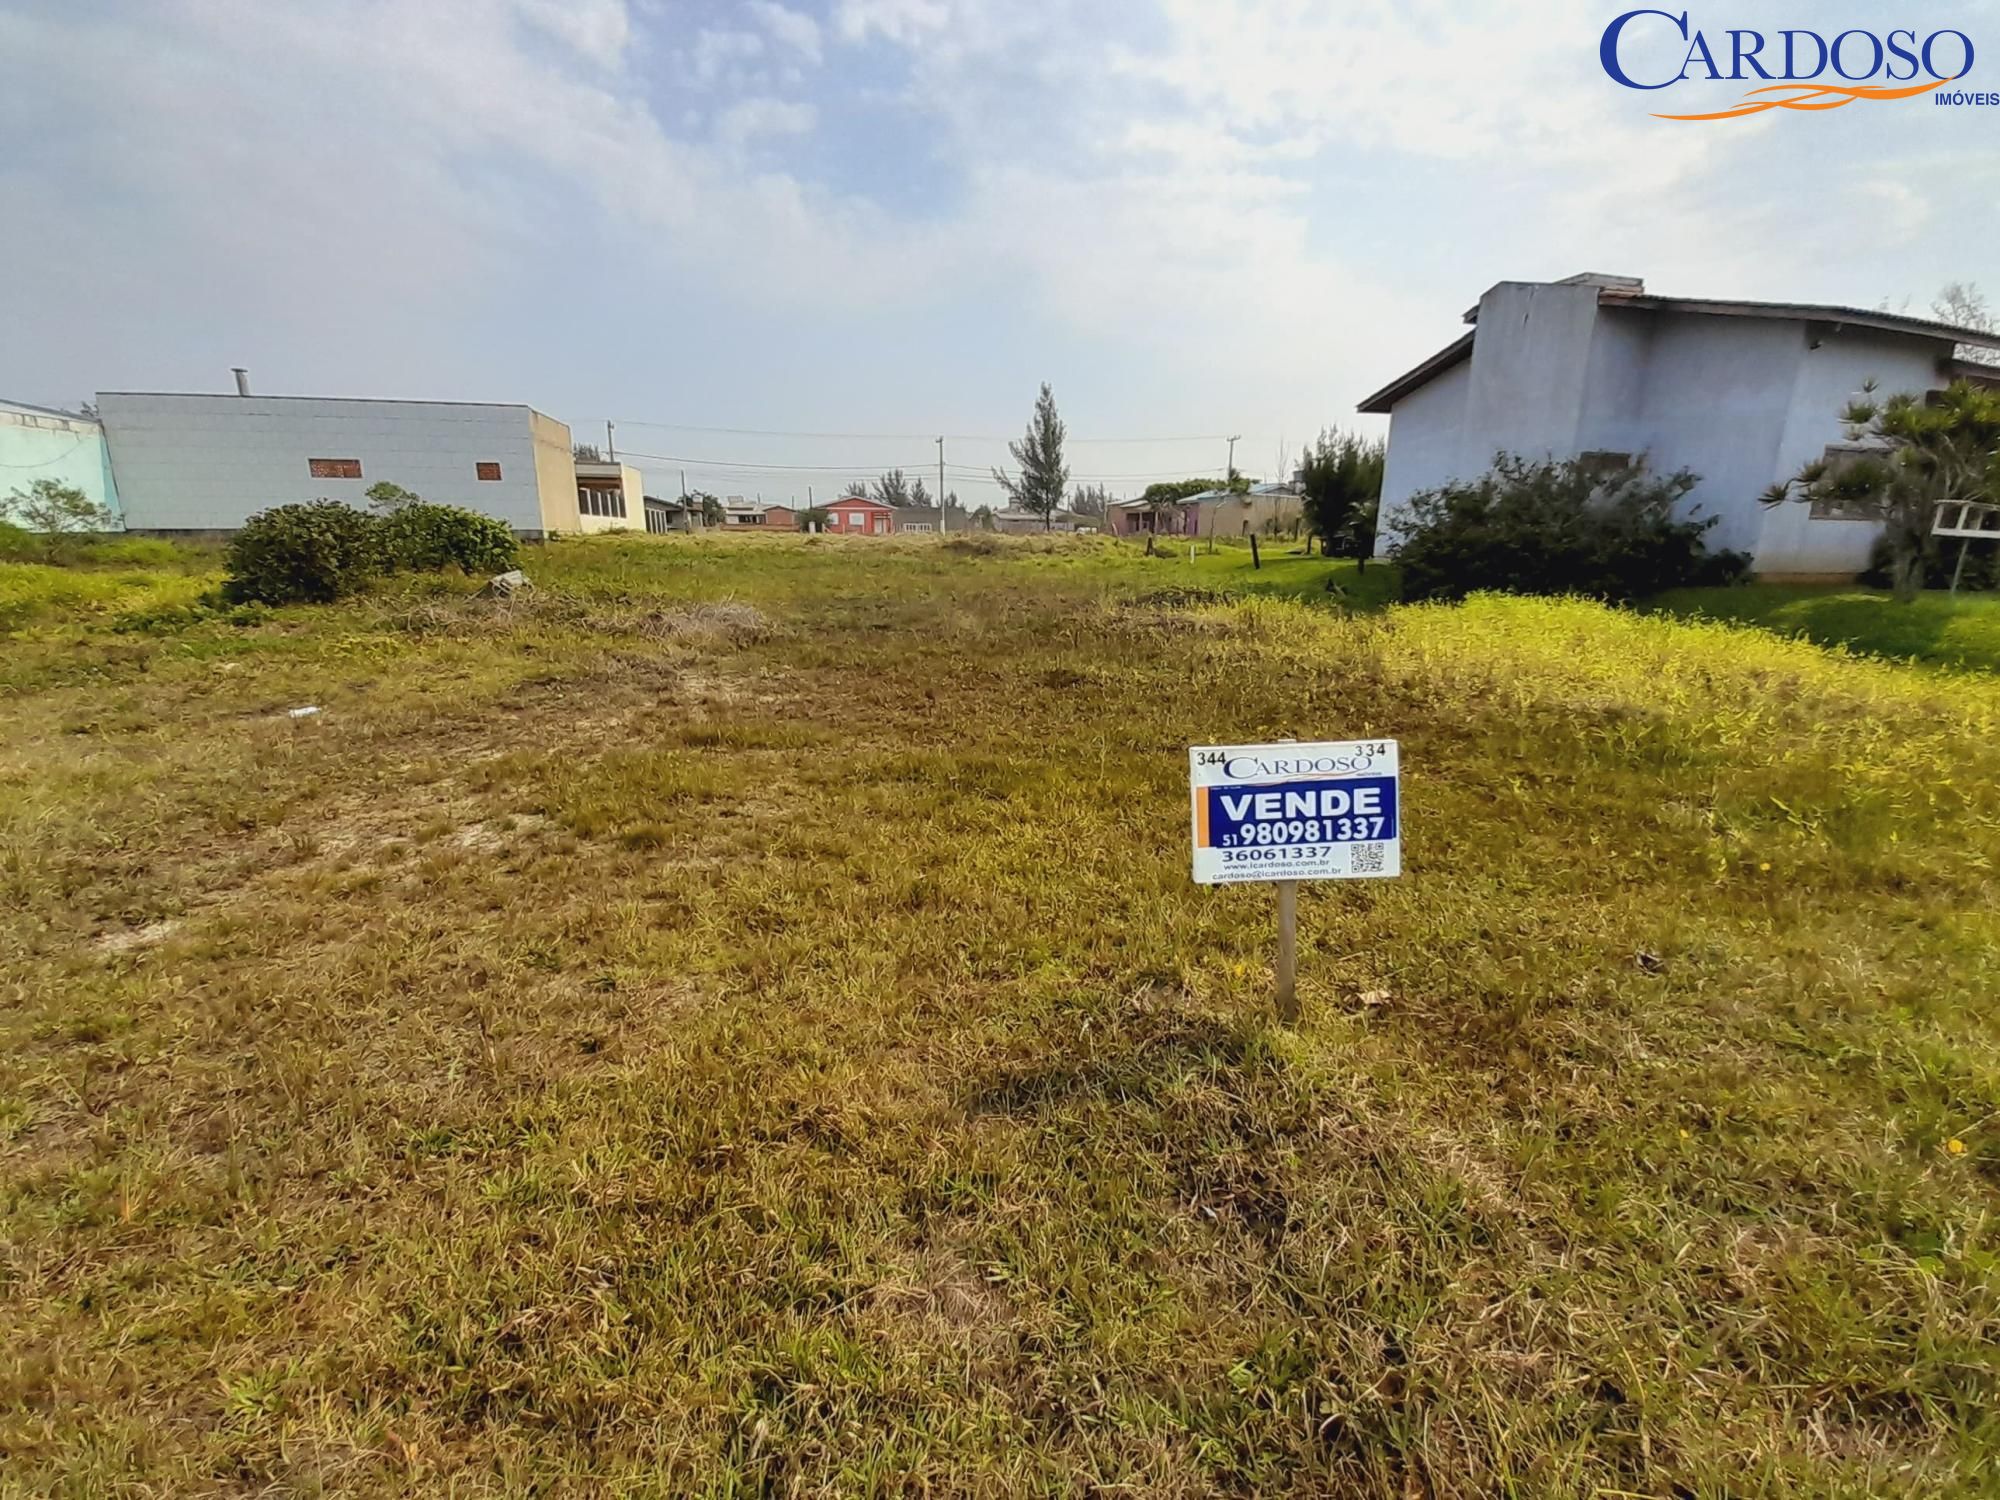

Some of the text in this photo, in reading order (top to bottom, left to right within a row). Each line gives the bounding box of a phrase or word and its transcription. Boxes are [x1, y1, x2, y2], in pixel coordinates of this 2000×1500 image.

[1197, 752, 1226, 766] 344
[1355, 743, 1386, 757] 334
[1223, 756, 1372, 778] CARDOSO
[1220, 787, 1382, 821] VENDE
[1222, 817, 1384, 846] 51 980981337
[1222, 846, 1332, 862] 36061337
